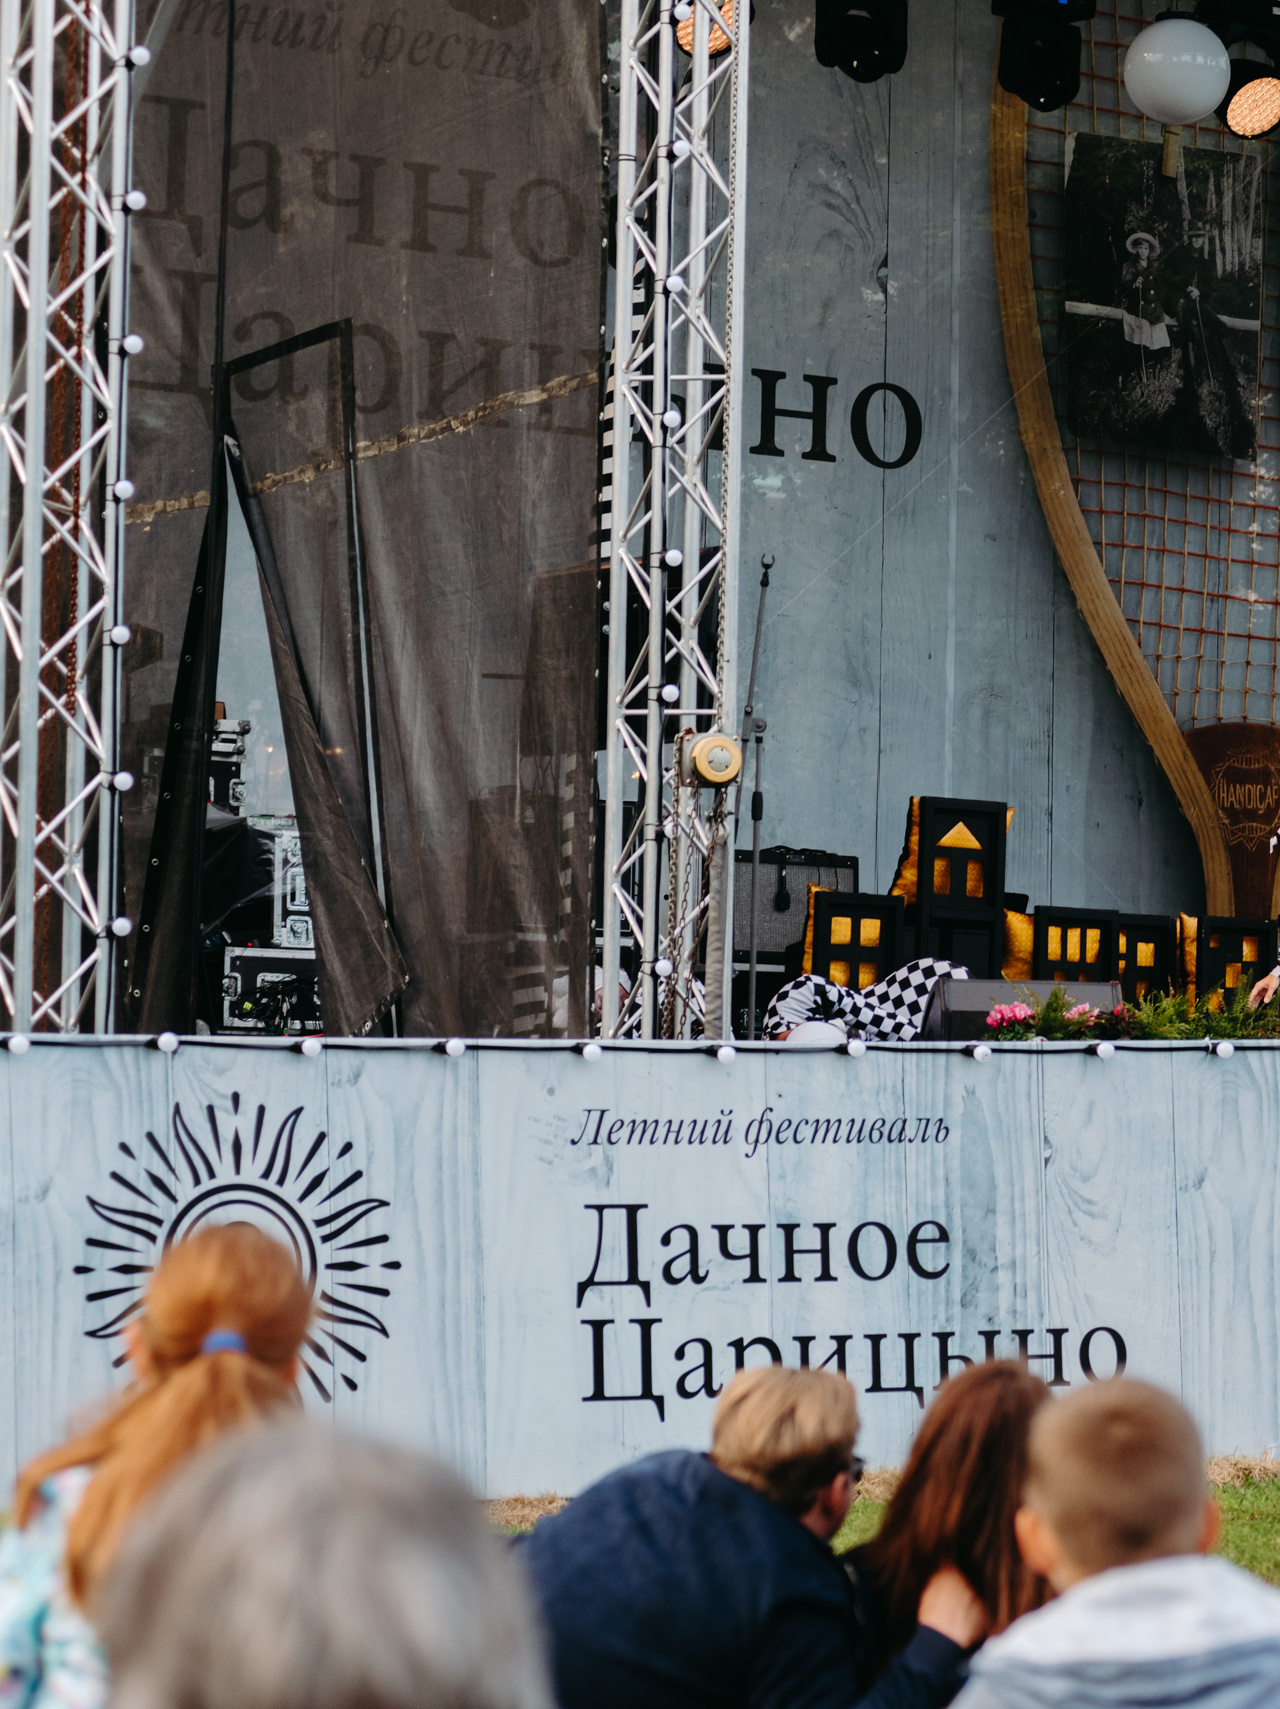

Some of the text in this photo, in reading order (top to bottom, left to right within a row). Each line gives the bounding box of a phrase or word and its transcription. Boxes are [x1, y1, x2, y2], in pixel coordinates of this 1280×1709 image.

[571, 1107, 950, 1159] Летний фестиваль
[576, 1204, 950, 1308] Дачное
